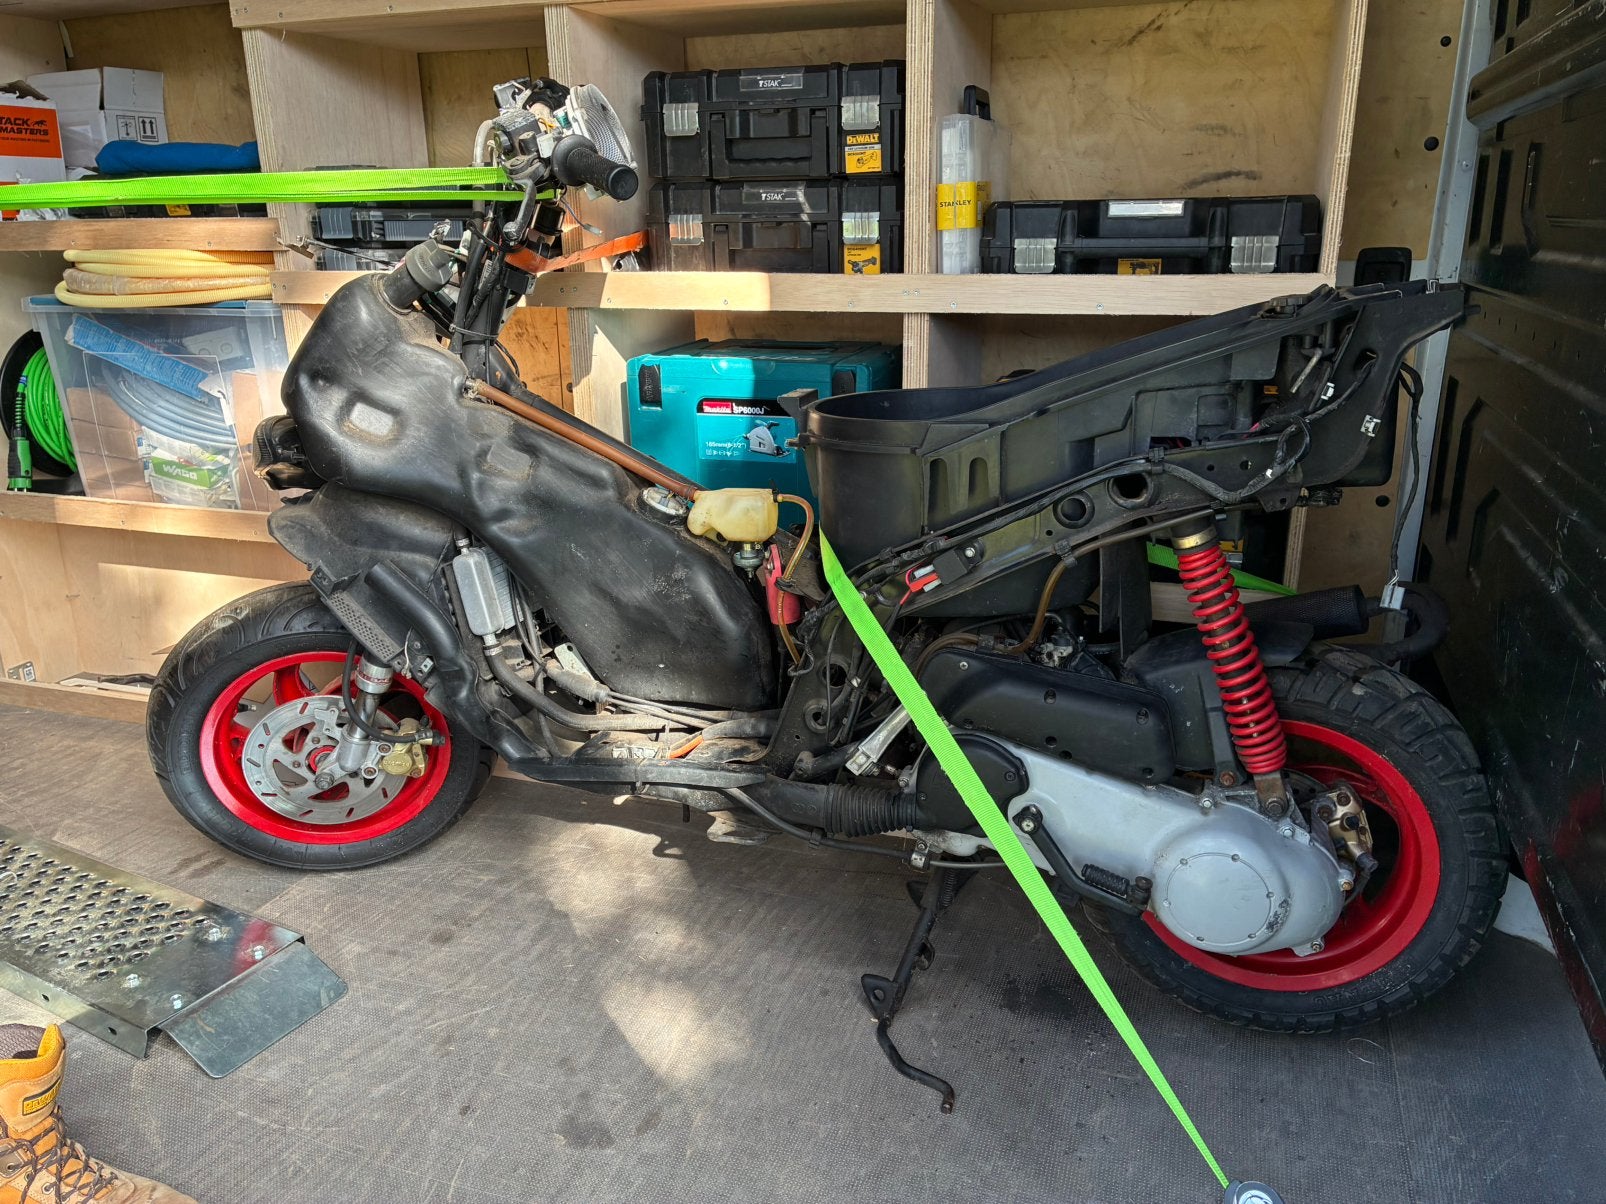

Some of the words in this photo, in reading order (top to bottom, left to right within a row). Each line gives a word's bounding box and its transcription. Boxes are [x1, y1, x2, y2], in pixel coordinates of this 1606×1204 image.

[847, 133, 879, 144] DEWALT
[939, 200, 972, 208] STANLEY
[733, 405, 765, 414] SP6000J
[163, 465, 198, 480] WAGO
